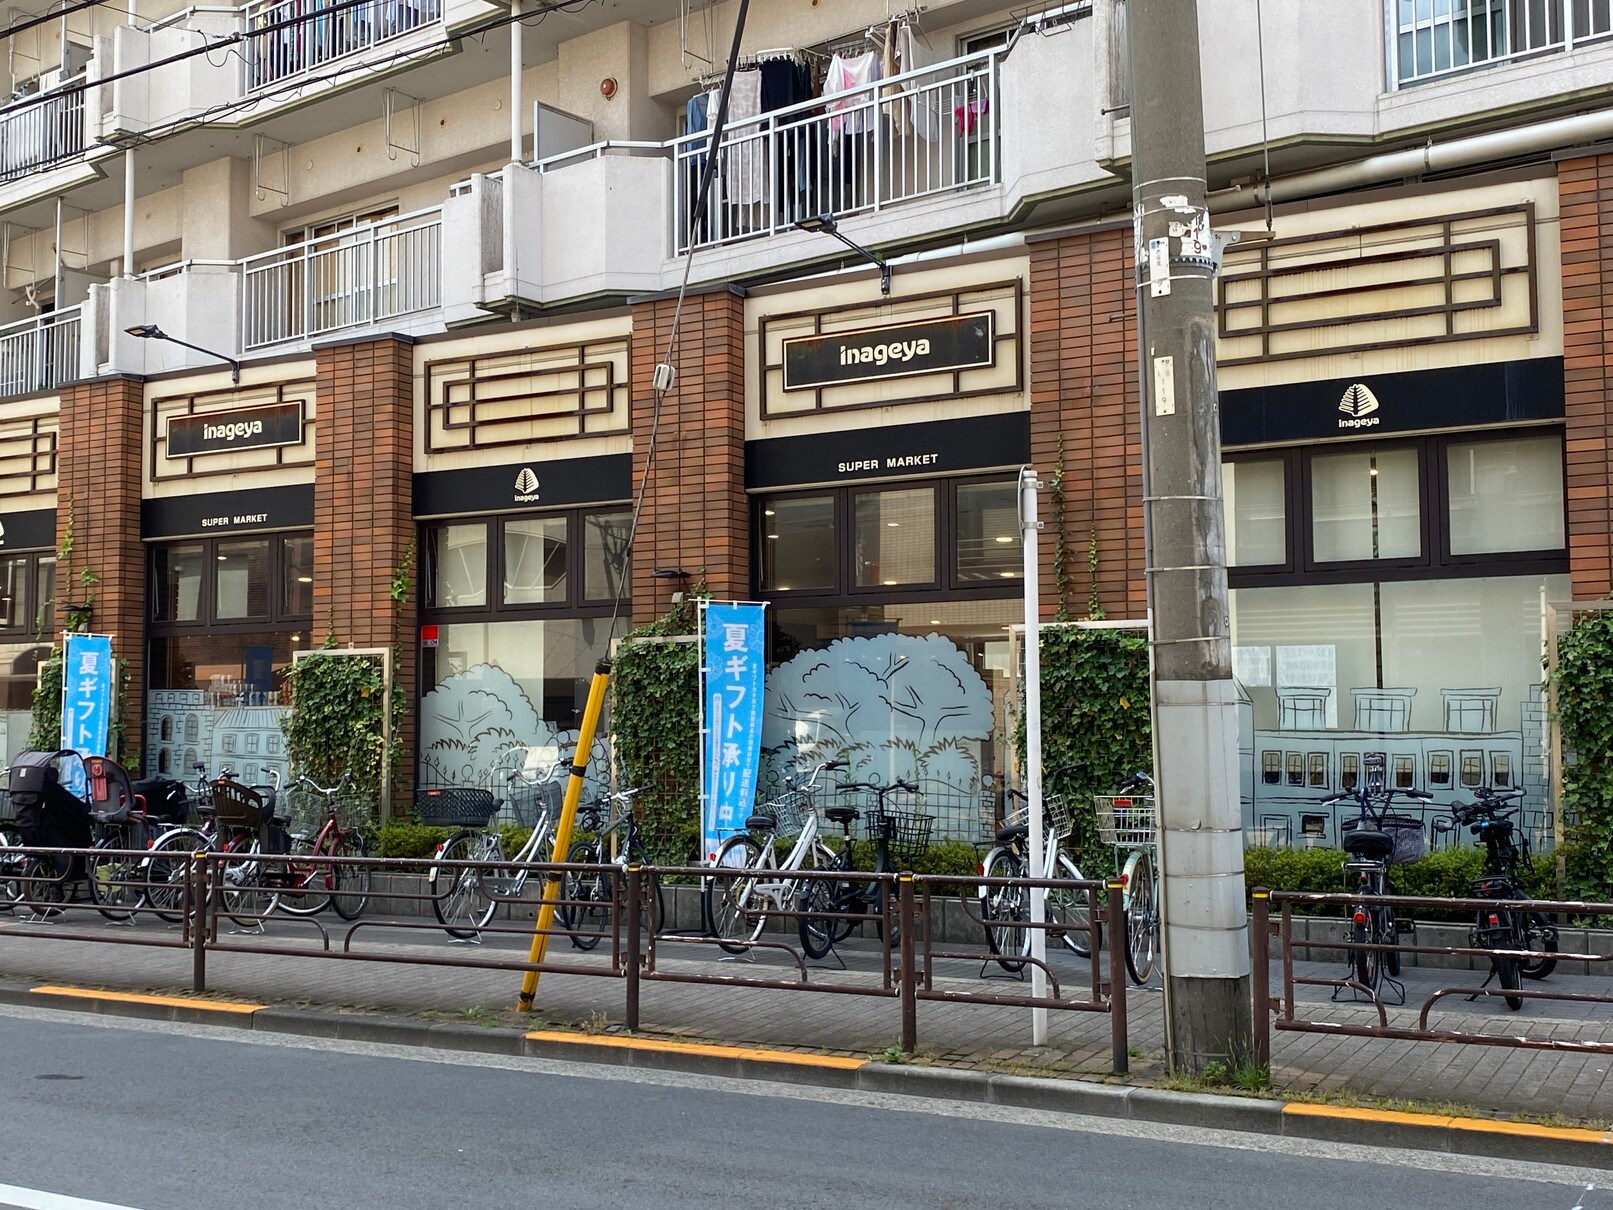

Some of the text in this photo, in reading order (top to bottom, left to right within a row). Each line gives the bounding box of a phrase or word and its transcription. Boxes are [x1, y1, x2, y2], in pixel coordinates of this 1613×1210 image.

[839, 338, 930, 366] inageya
[203, 420, 263, 441] inageya
[1338, 417, 1380, 429] inageya
[838, 453, 939, 473] SUPER MARKET
[514, 494, 540, 503] inageya
[201, 513, 268, 527] SUPER MARKET
[718, 623, 749, 828] 夏ギフト承り中
